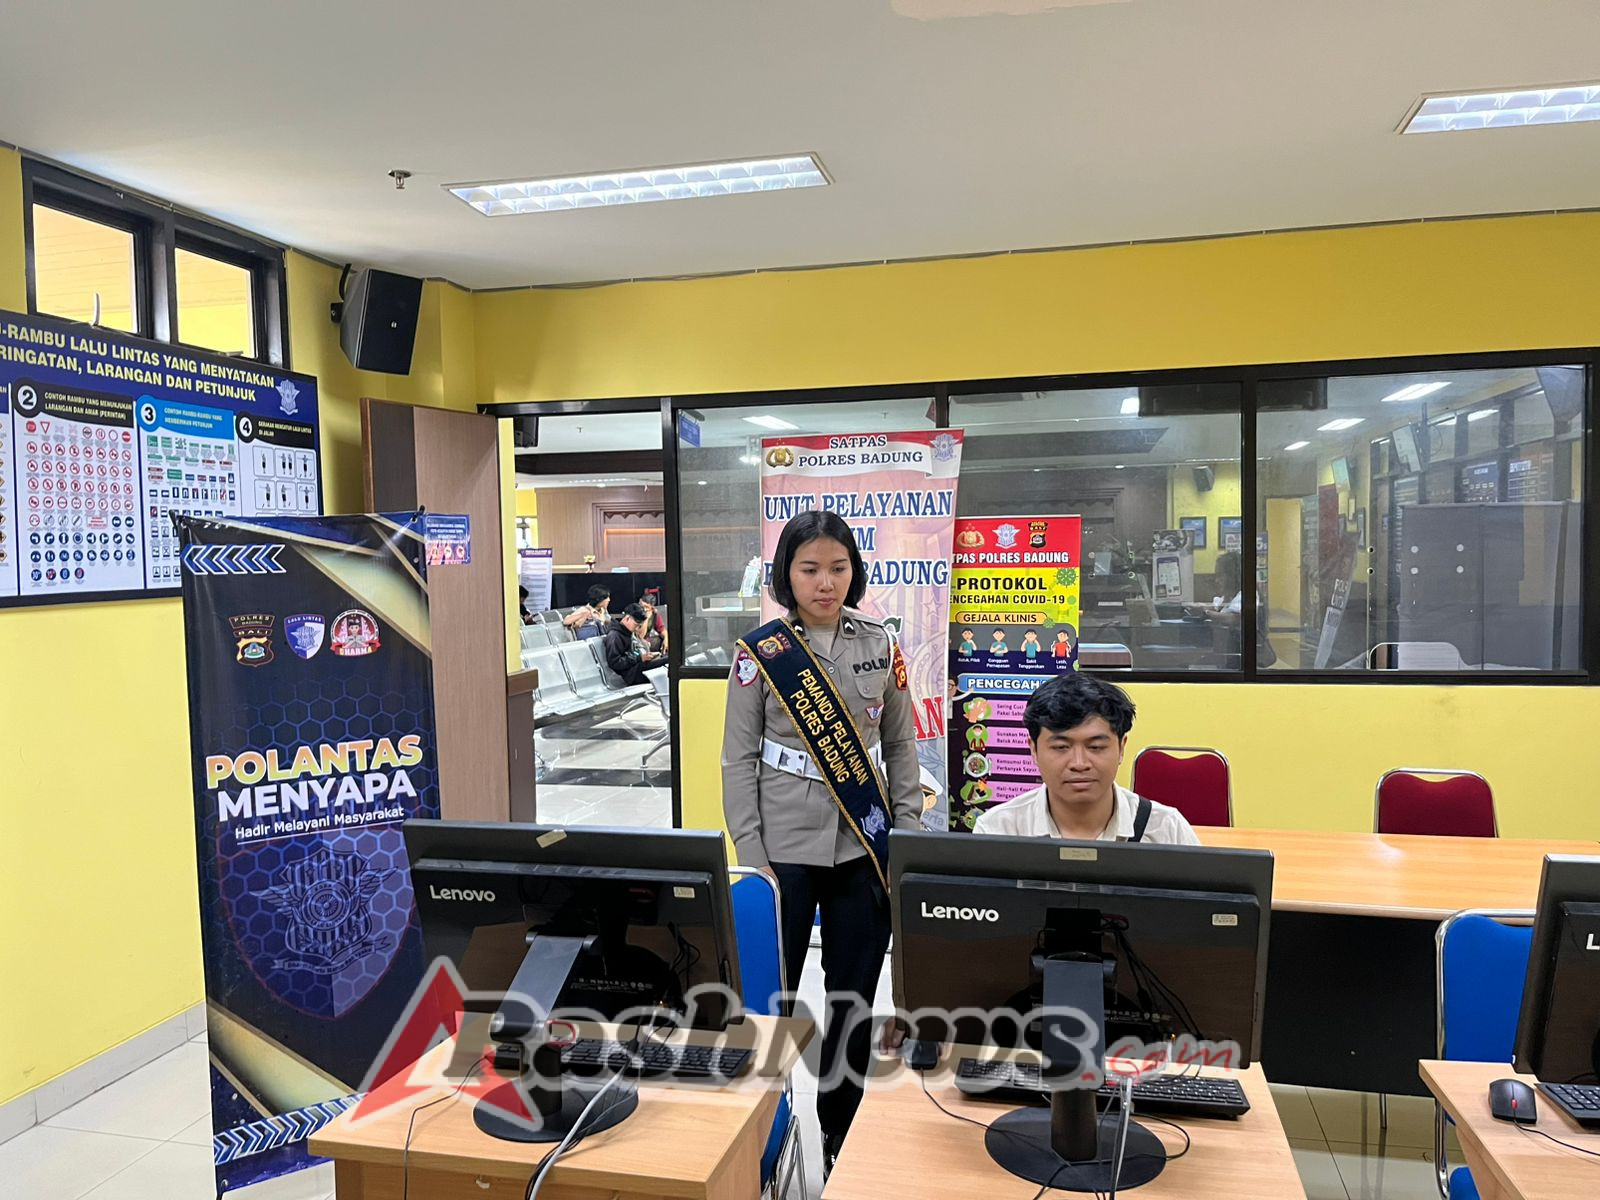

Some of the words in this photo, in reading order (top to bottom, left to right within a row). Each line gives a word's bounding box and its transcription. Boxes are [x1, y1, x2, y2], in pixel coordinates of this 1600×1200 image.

[0, 323, 65, 348] -RAMBU
[70, 336, 107, 356] LALU
[112, 344, 160, 366] LINTAS
[163, 354, 197, 374] YANG
[200, 364, 274, 389] MENYATAKAN
[87, 360, 162, 385] LARANGAN
[166, 374, 191, 391] DAN
[195, 380, 256, 402] PETUNJUK
[22, 389, 34, 406] 2
[144, 406, 154, 421] 3
[242, 420, 250, 433] 4
[830, 436, 887, 449] SATPAS
[798, 454, 856, 467] POLRES
[861, 451, 923, 465] BADUNG
[764, 495, 815, 520] UNIT
[822, 490, 953, 518] PELAYANAN
[979, 552, 1020, 564] POLRES
[1024, 551, 1069, 563] BADUNG
[957, 577, 1047, 590] PROTOKOL
[1013, 594, 1066, 604] COVID-19
[963, 613, 1000, 623] GEJALA
[1004, 614, 1037, 623] KLINIS
[967, 678, 1046, 690] PENCEGAH
[797, 668, 838, 721] PEMANDU
[829, 720, 869, 786] PELAYANAN
[790, 689, 825, 736] POLRES
[817, 735, 850, 783] BADUNG
[206, 735, 423, 789] POLANTAS
[218, 770, 417, 822] MENYAPA
[235, 821, 270, 840] Hadir
[274, 815, 331, 834] Melayani
[334, 805, 404, 825] Masyarakat
[429, 884, 496, 902] Lenovo
[921, 901, 999, 923] Lenovo
